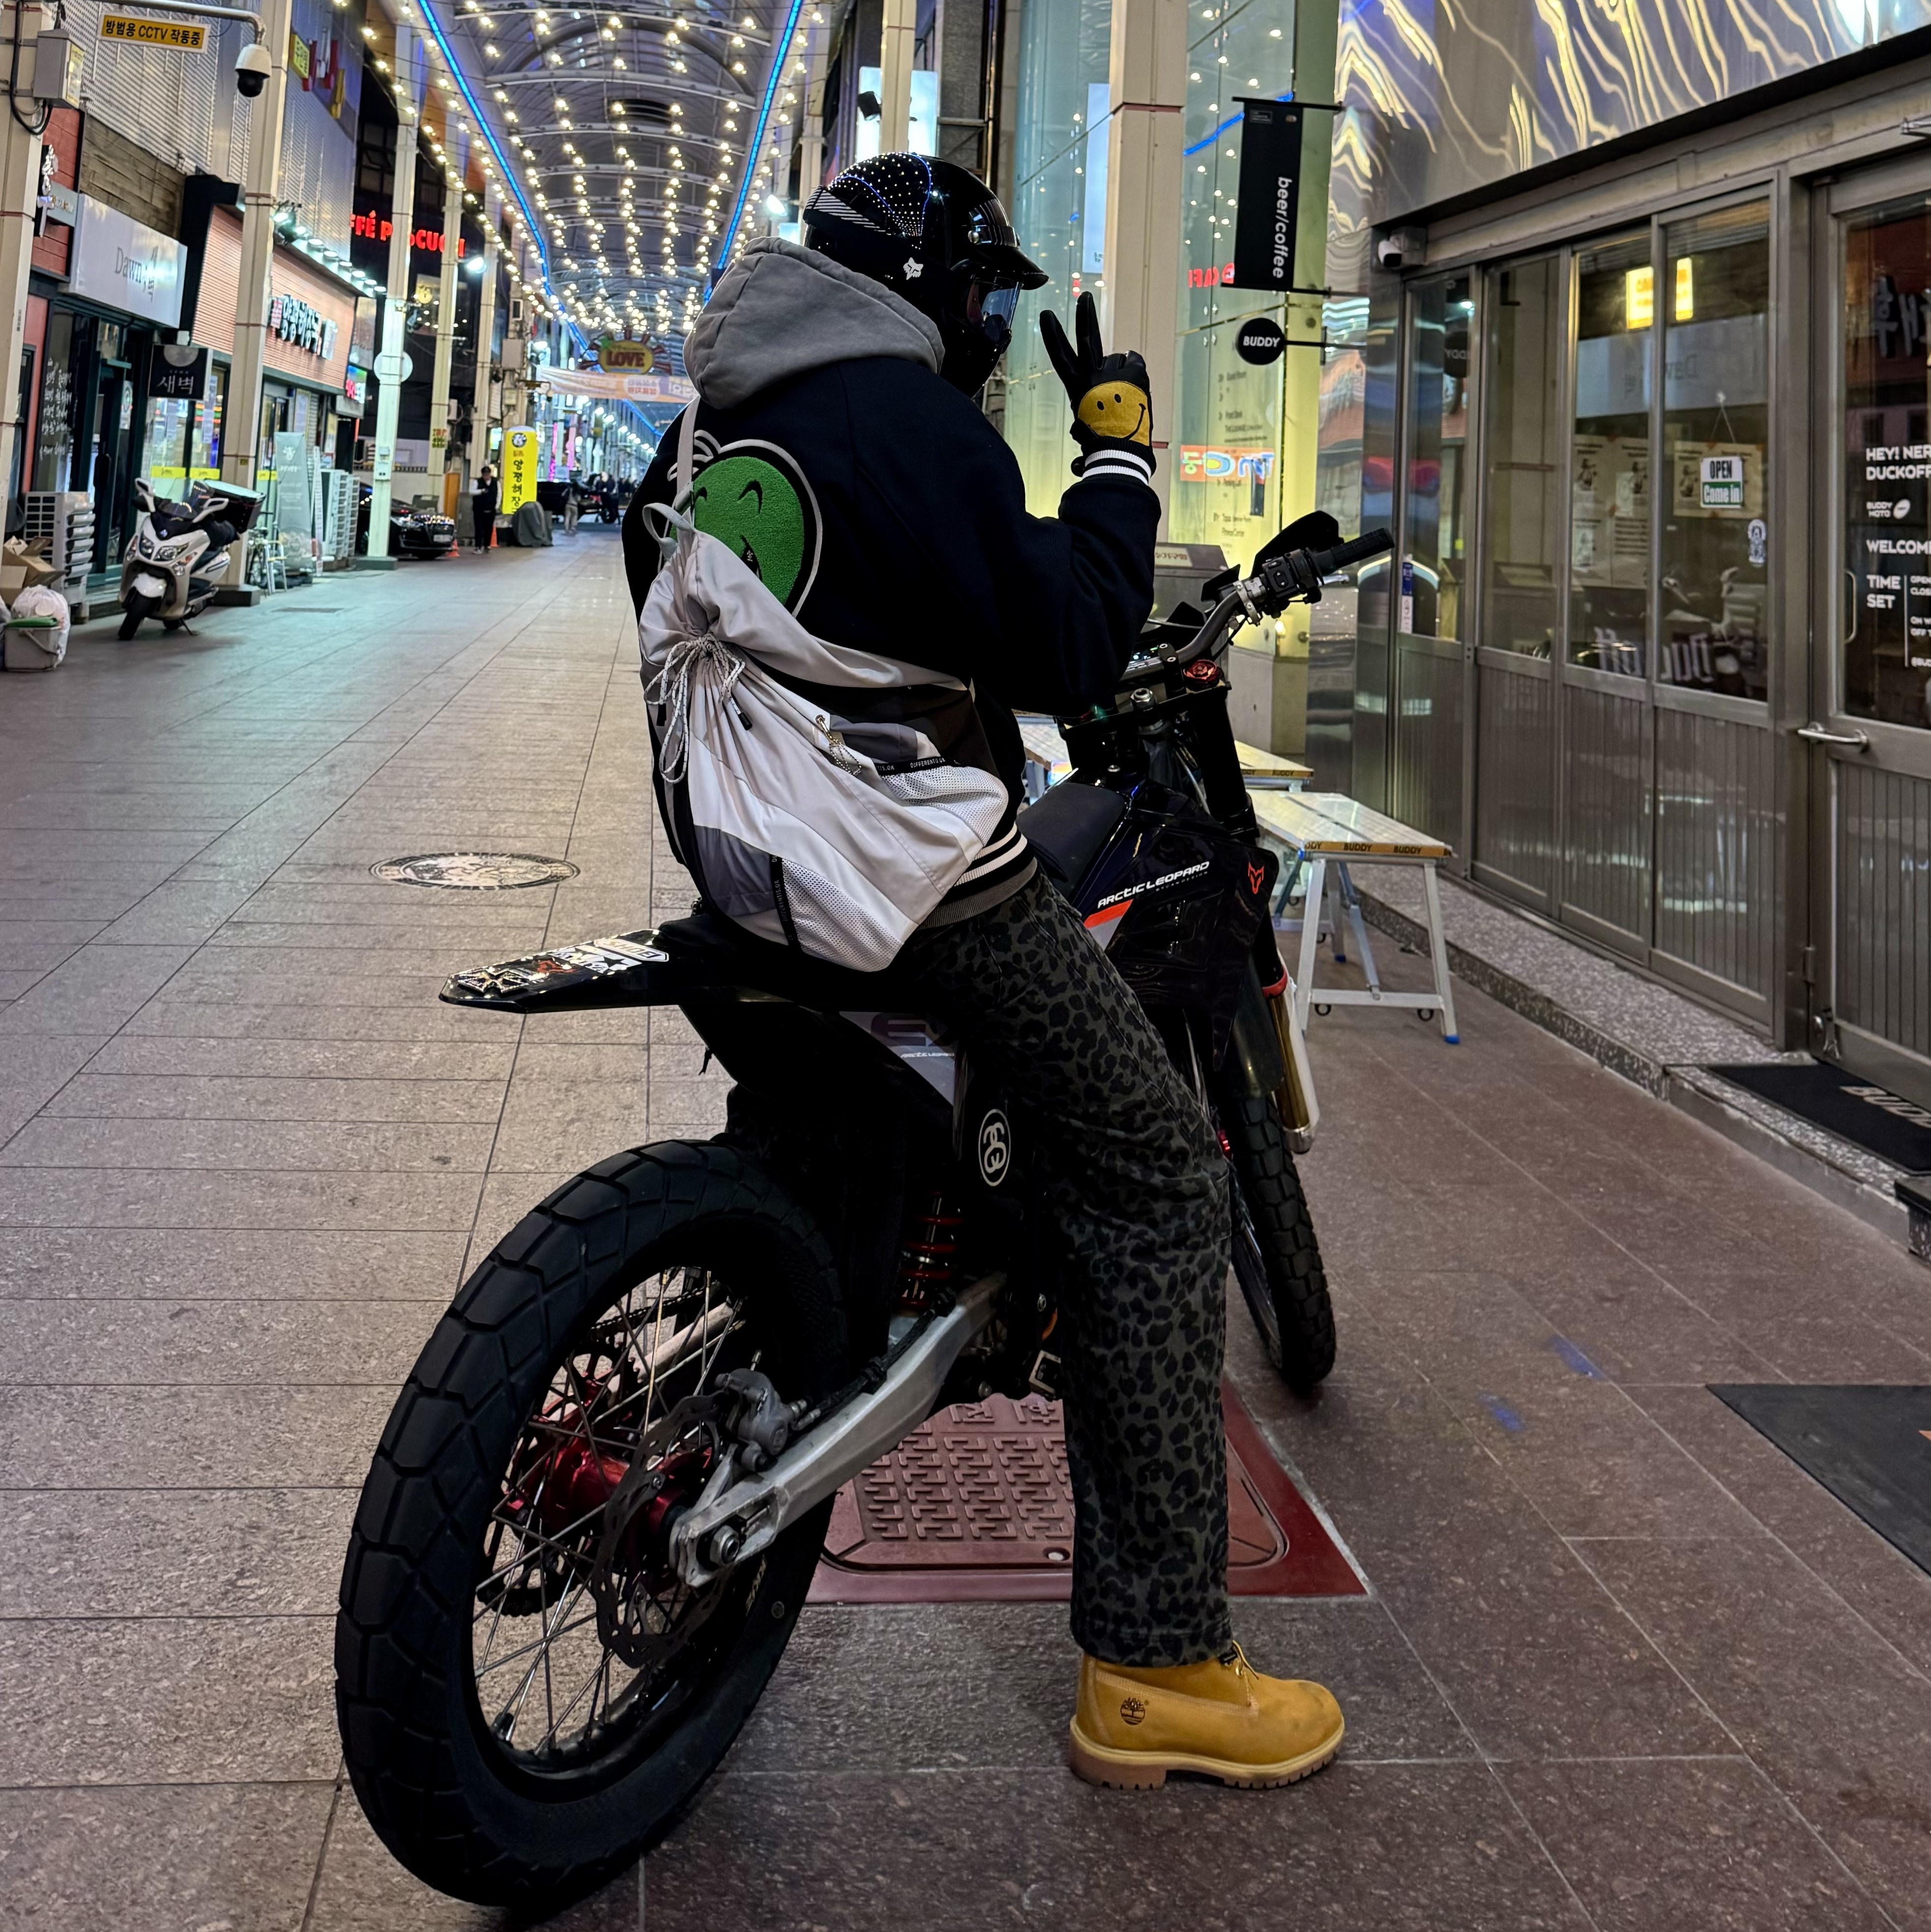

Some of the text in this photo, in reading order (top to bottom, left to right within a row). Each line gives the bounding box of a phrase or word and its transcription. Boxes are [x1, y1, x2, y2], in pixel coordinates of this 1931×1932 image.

[106, 20, 201, 46] 방범용 CCTV 작동중
[1272, 177, 1292, 278] beer/coffee
[1243, 336, 1280, 347] BUDDY
[606, 350, 645, 367] LOVE
[157, 374, 194, 395] 새벽
[1866, 446, 1900, 461] HEY!
[1710, 460, 1732, 479] OPEN
[1704, 484, 1740, 503] Come in
[1867, 501, 1892, 510] BUDDY
[1869, 510, 1891, 518] MOTO
[1866, 574, 1901, 590] TIME
[1867, 593, 1896, 609] SET
[1344, 842, 1373, 852] BUDDY
[1393, 845, 1422, 855] BUDDY
[1146, 861, 1210, 889] LEOPARD
